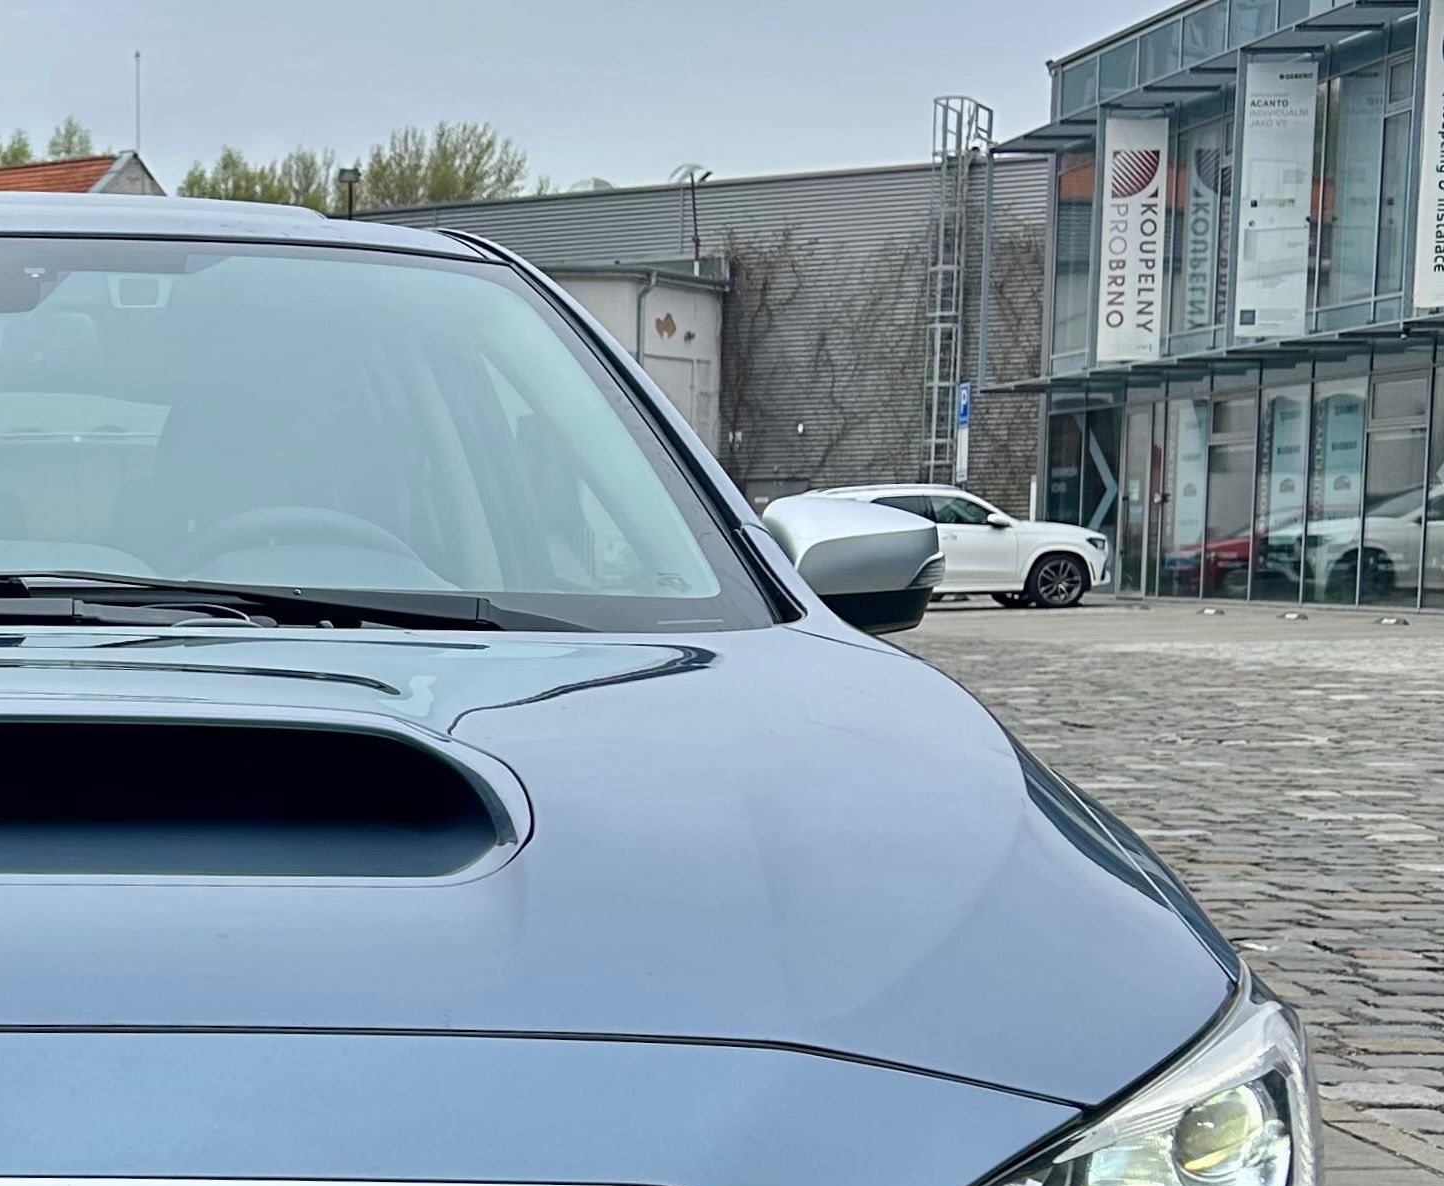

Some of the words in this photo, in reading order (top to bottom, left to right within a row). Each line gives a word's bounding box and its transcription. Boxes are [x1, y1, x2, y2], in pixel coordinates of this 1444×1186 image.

[1250, 99, 1289, 107] ACANTO
[1136, 203, 1158, 333] KOUPELNY
[960, 388, 968, 414] P
